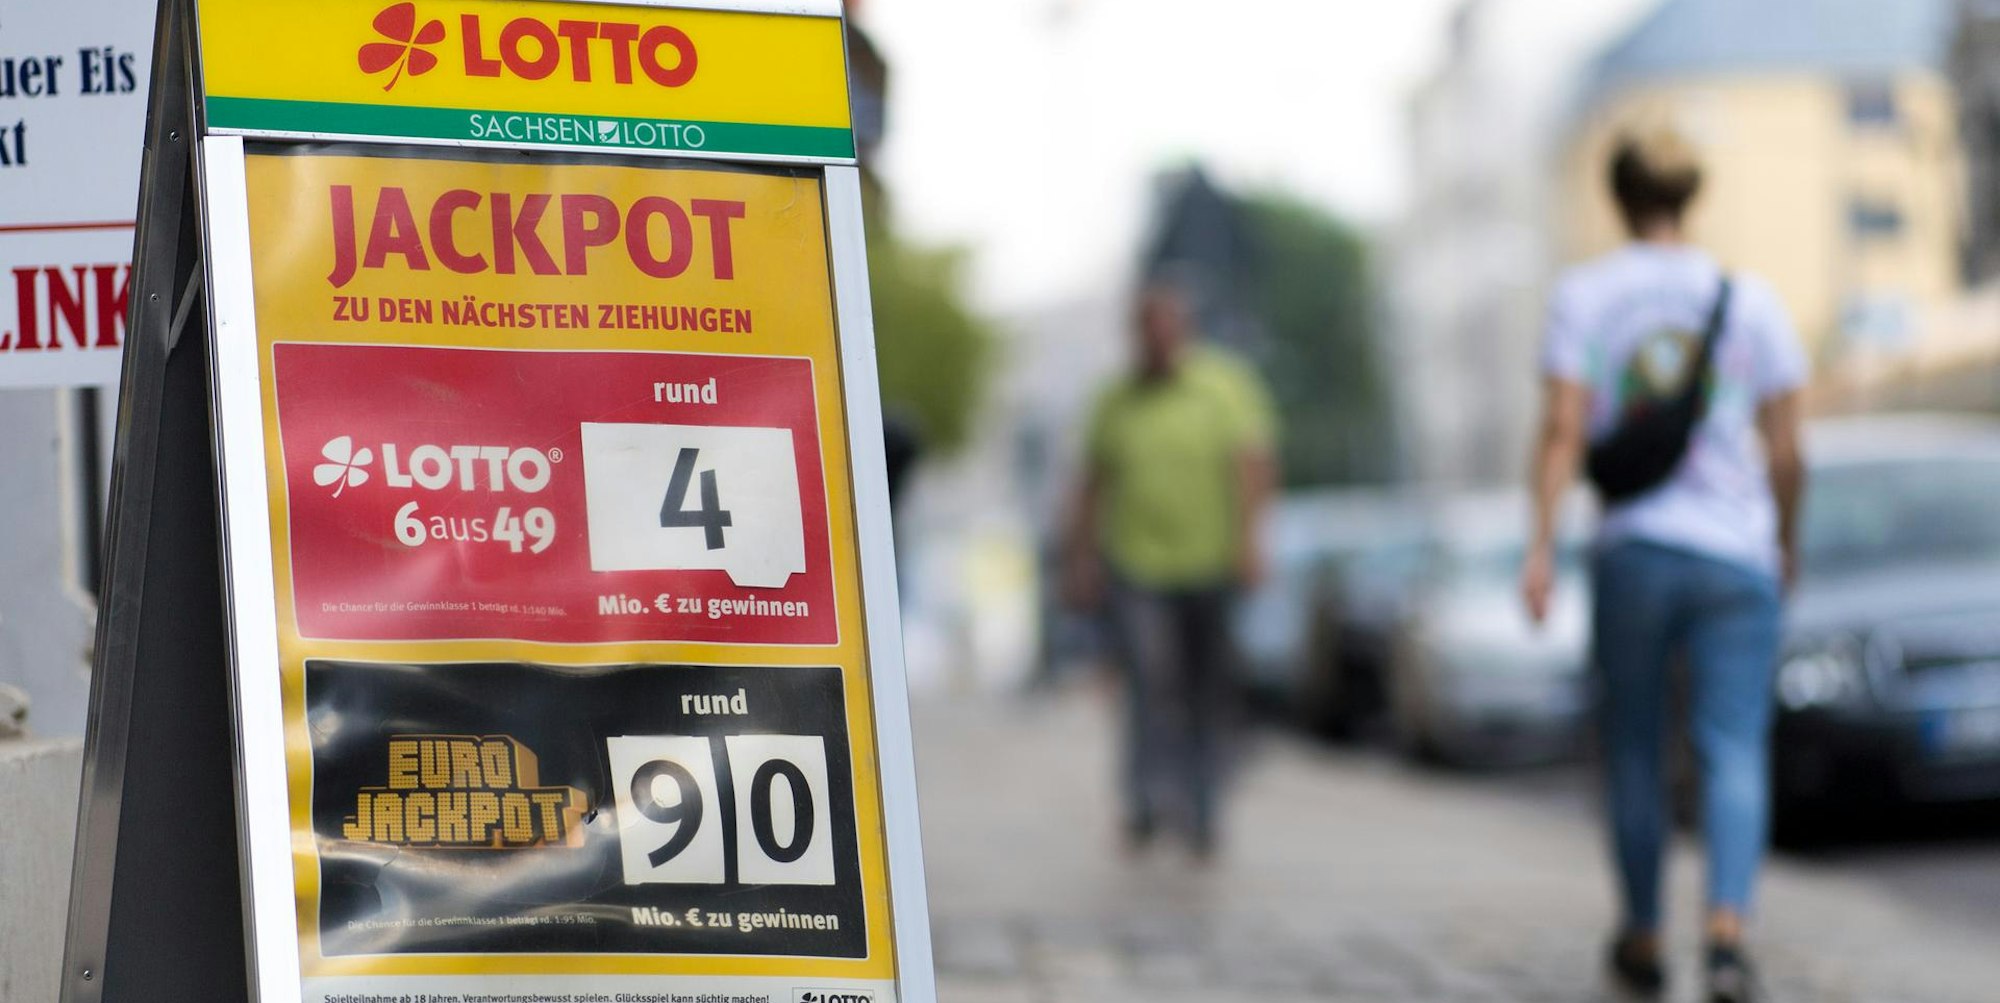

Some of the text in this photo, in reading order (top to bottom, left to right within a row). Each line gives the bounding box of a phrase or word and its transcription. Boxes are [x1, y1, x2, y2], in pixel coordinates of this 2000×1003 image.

[462, 14, 698, 88] LOTTO
[79, 46, 136, 94] Eis
[469, 113, 705, 148] SACHSEN LOTTO
[327, 184, 746, 289] JACKPOT
[333, 296, 752, 334] ZU DEN NÄCHSTEN ZIEHUNGEN
[654, 377, 717, 405] rund
[660, 447, 732, 551] 4
[322, 601, 339, 613] Die
[340, 601, 374, 613] Chance
[375, 600, 388, 612] für
[390, 601, 405, 612] die
[406, 600, 470, 612] Gewinnklasse
[598, 594, 809, 620] Mio. € zu gewinnen
[681, 688, 748, 715] rund
[388, 739, 512, 789] EURO
[343, 791, 563, 843] JACKPOT
[418, 917, 433, 927] die
[632, 907, 839, 931] Mio. € zu gewinnen
[324, 994, 397, 1003] Spielteilnahme
[400, 994, 411, 1003] ab
[415, 995, 426, 1003] 18
[463, 993, 571, 1003] Verantwortungsbewusst
[574, 993, 613, 1003] spielen.
[615, 993, 669, 1003] Glücksspiel
[671, 993, 693, 1003] kann
[696, 994, 729, 1003] süchtig
[732, 994, 770, 1003] machen!
